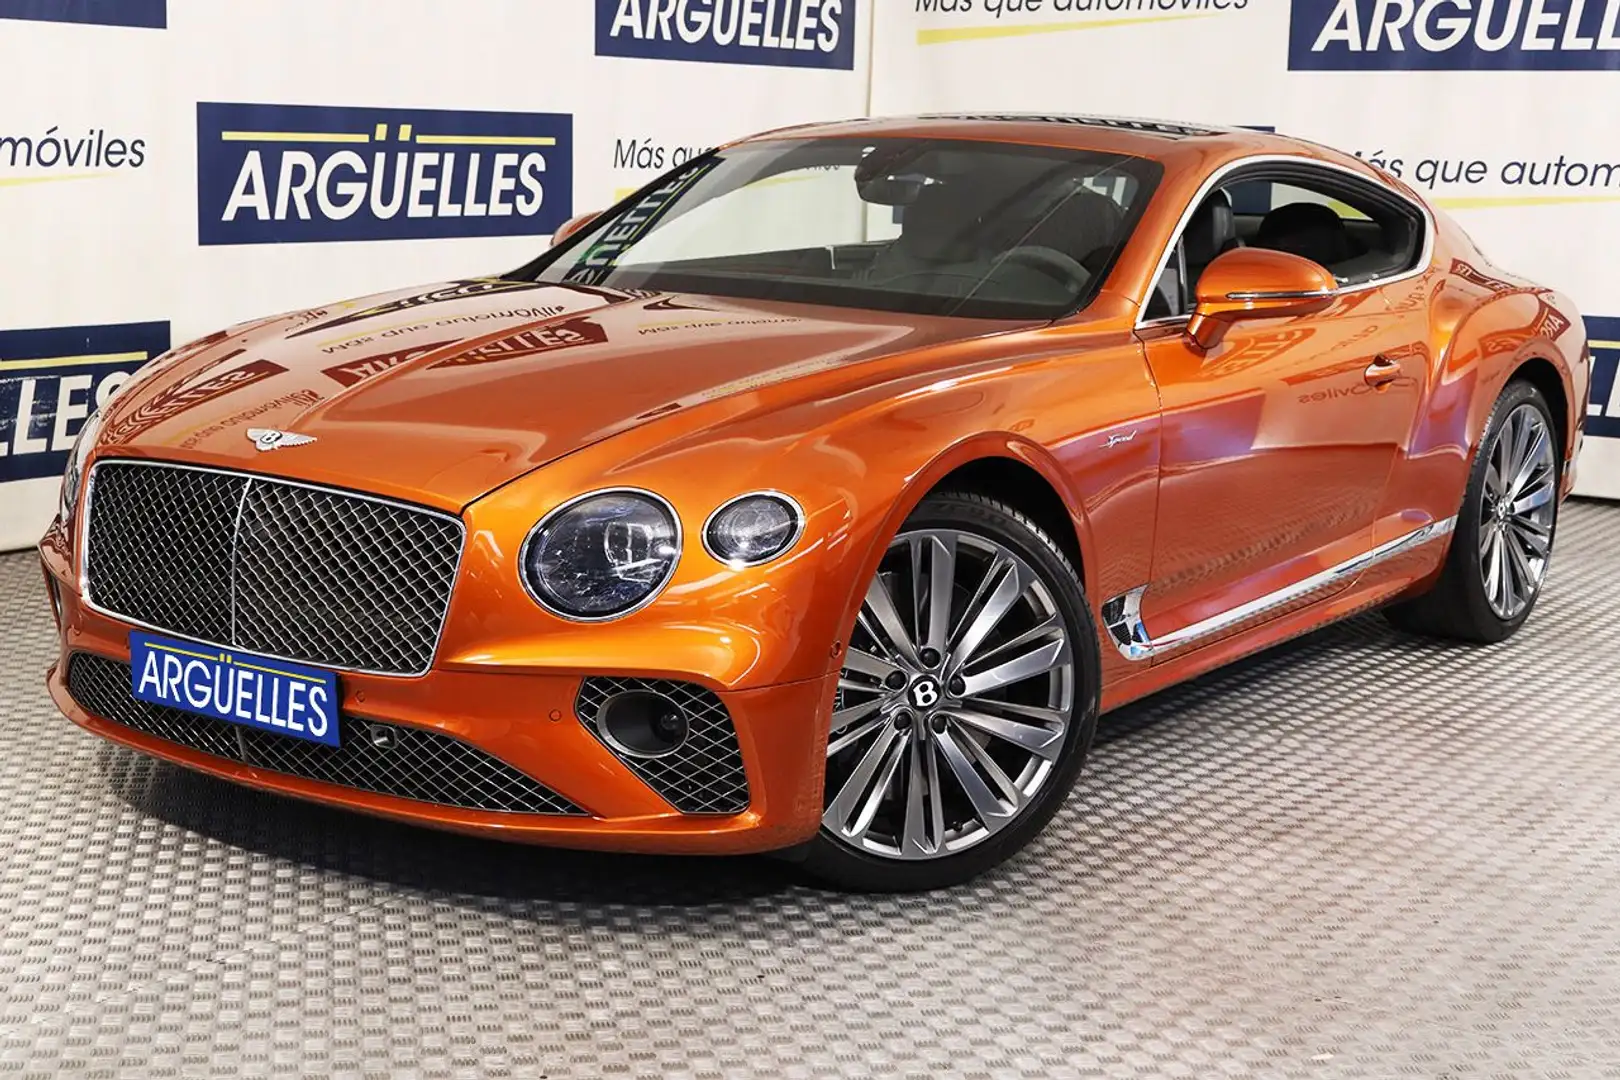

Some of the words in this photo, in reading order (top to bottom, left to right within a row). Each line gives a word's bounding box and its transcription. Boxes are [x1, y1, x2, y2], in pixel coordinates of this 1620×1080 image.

[613, 138, 665, 169] Más
[220, 123, 547, 221] ARGÜELLES
[1415, 158, 1488, 190] que
[138, 650, 329, 738] ARGÜELLES
[912, 680, 939, 708] B
